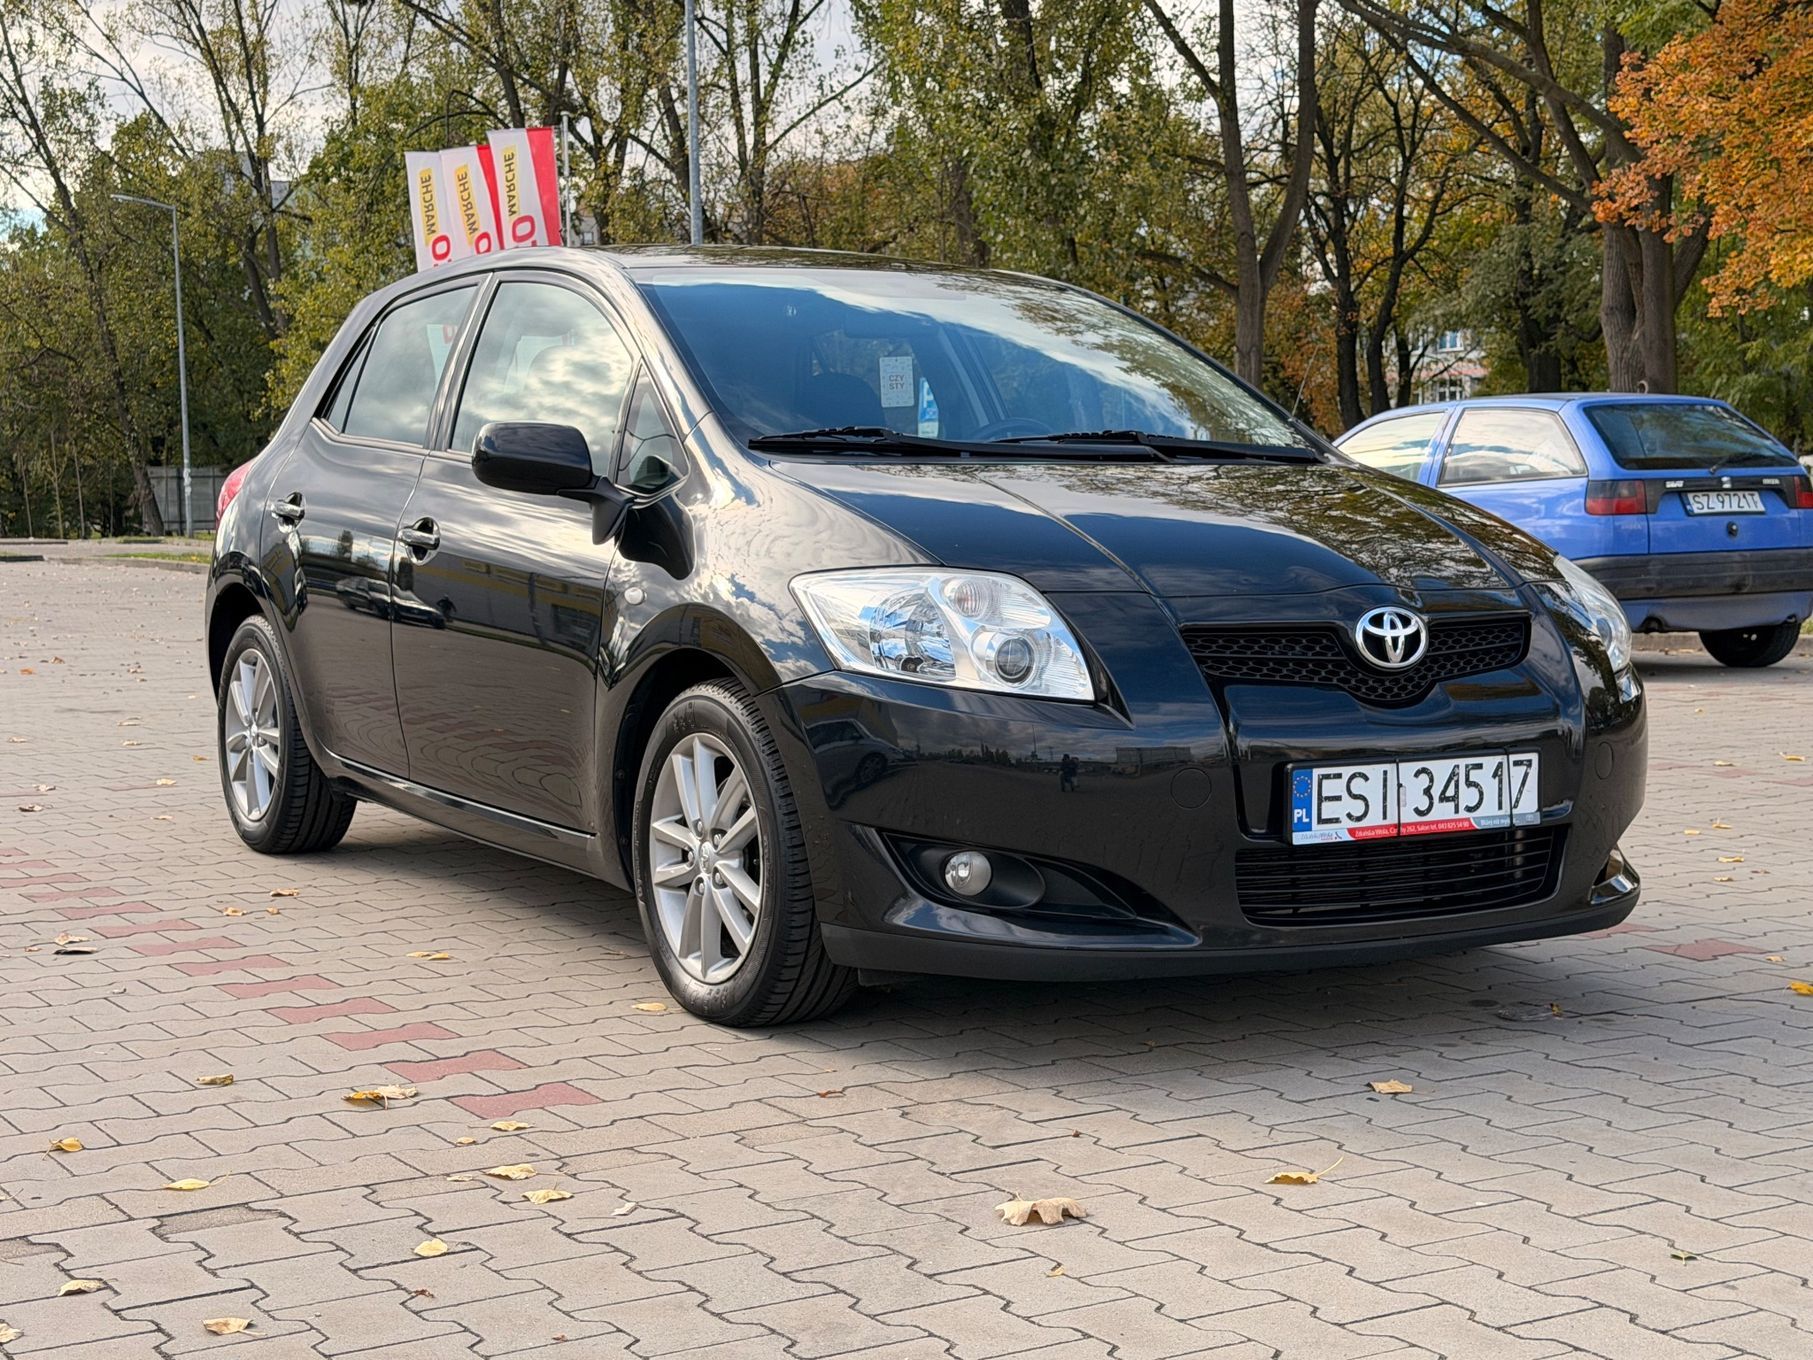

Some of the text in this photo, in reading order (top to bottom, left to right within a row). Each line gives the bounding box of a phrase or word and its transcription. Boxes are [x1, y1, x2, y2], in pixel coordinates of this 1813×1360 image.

[1692, 493, 1716, 510] SZ
[1716, 492, 1759, 509] 9721T
[1316, 758, 1533, 825] ESI 34517
[1293, 808, 1310, 824] PL
